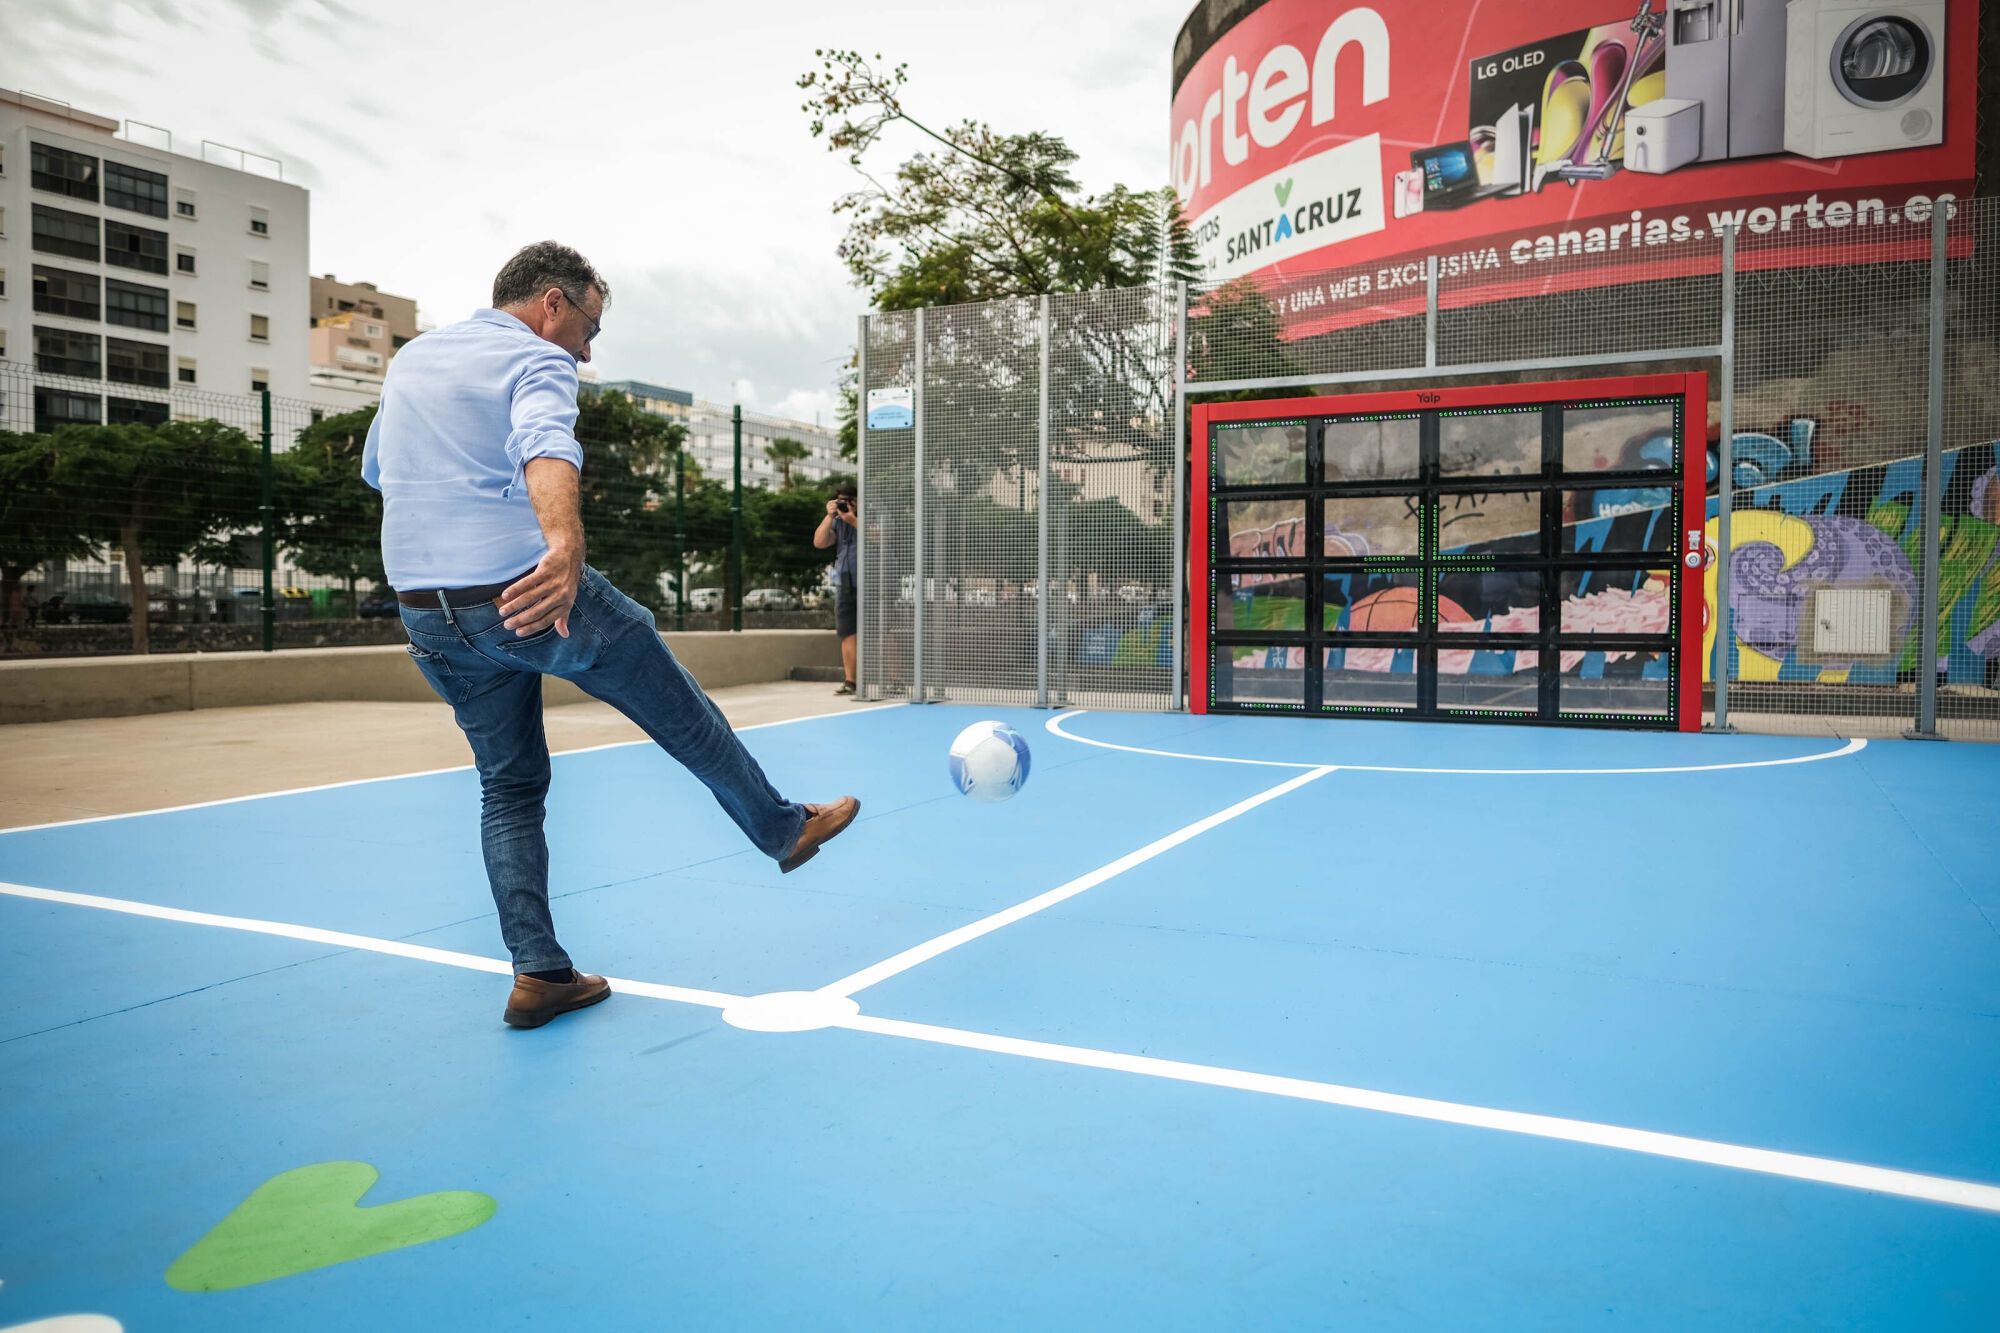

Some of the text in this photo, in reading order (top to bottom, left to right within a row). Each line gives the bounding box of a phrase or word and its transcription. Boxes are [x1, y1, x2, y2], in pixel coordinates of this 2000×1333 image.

[1477, 50, 1545, 80] LG OLED
[1277, 293, 1288, 316] Y
[1291, 285, 1325, 313] UNA
[1329, 274, 1372, 301] WEB
[1416, 391, 1441, 405] Yalp
